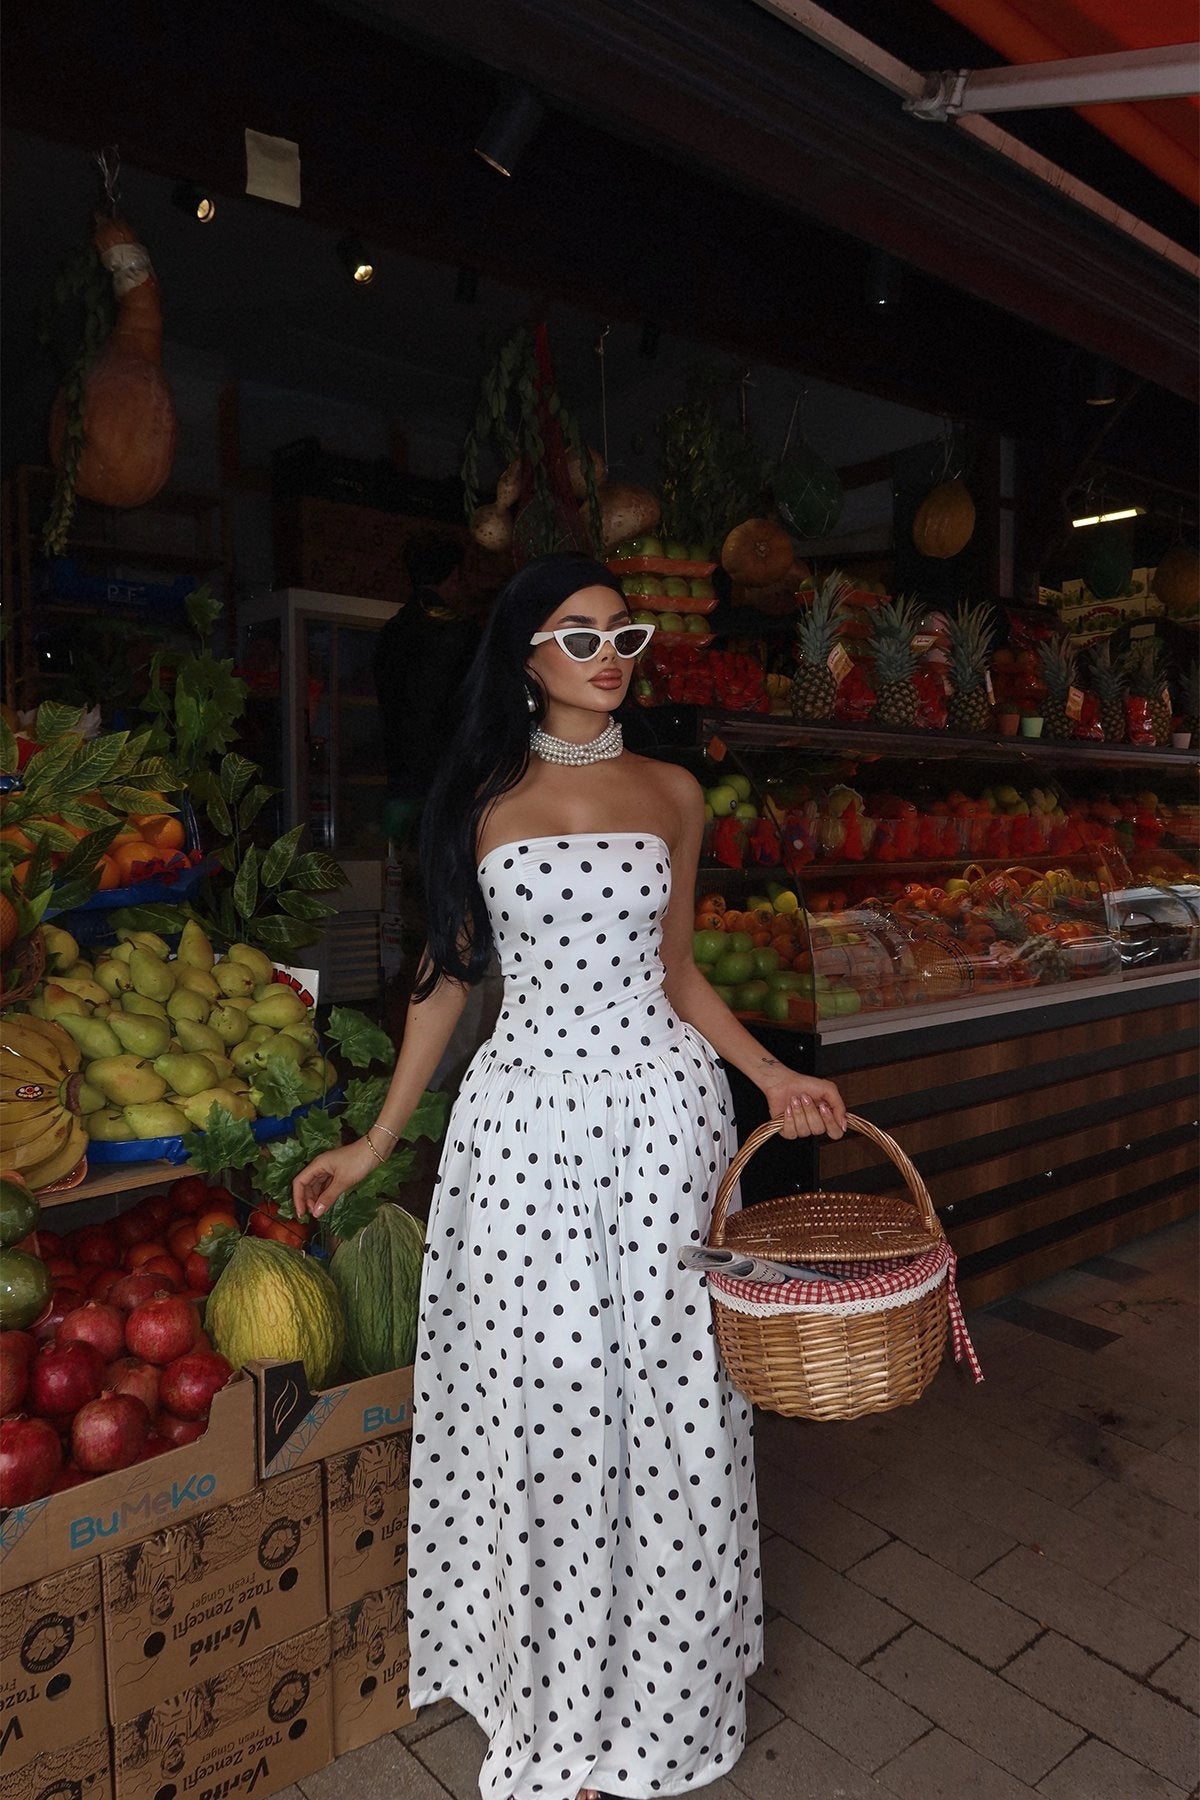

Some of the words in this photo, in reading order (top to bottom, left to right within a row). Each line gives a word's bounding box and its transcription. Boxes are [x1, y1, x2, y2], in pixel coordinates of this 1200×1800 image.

[70, 1473, 216, 1550] BuMeKo
[382, 1517, 408, 1541] cefil
[229, 1572, 256, 1593] Fresh
[239, 1579, 274, 1605] Taze
[190, 1588, 225, 1611] Ginger
[173, 1597, 234, 1641] Zencefil
[384, 1659, 408, 1684] cefil
[238, 1724, 265, 1745] Fresh
[248, 1731, 283, 1756] Taze
[200, 1741, 235, 1764] Ginger
[183, 1749, 243, 1792] Zencefil
